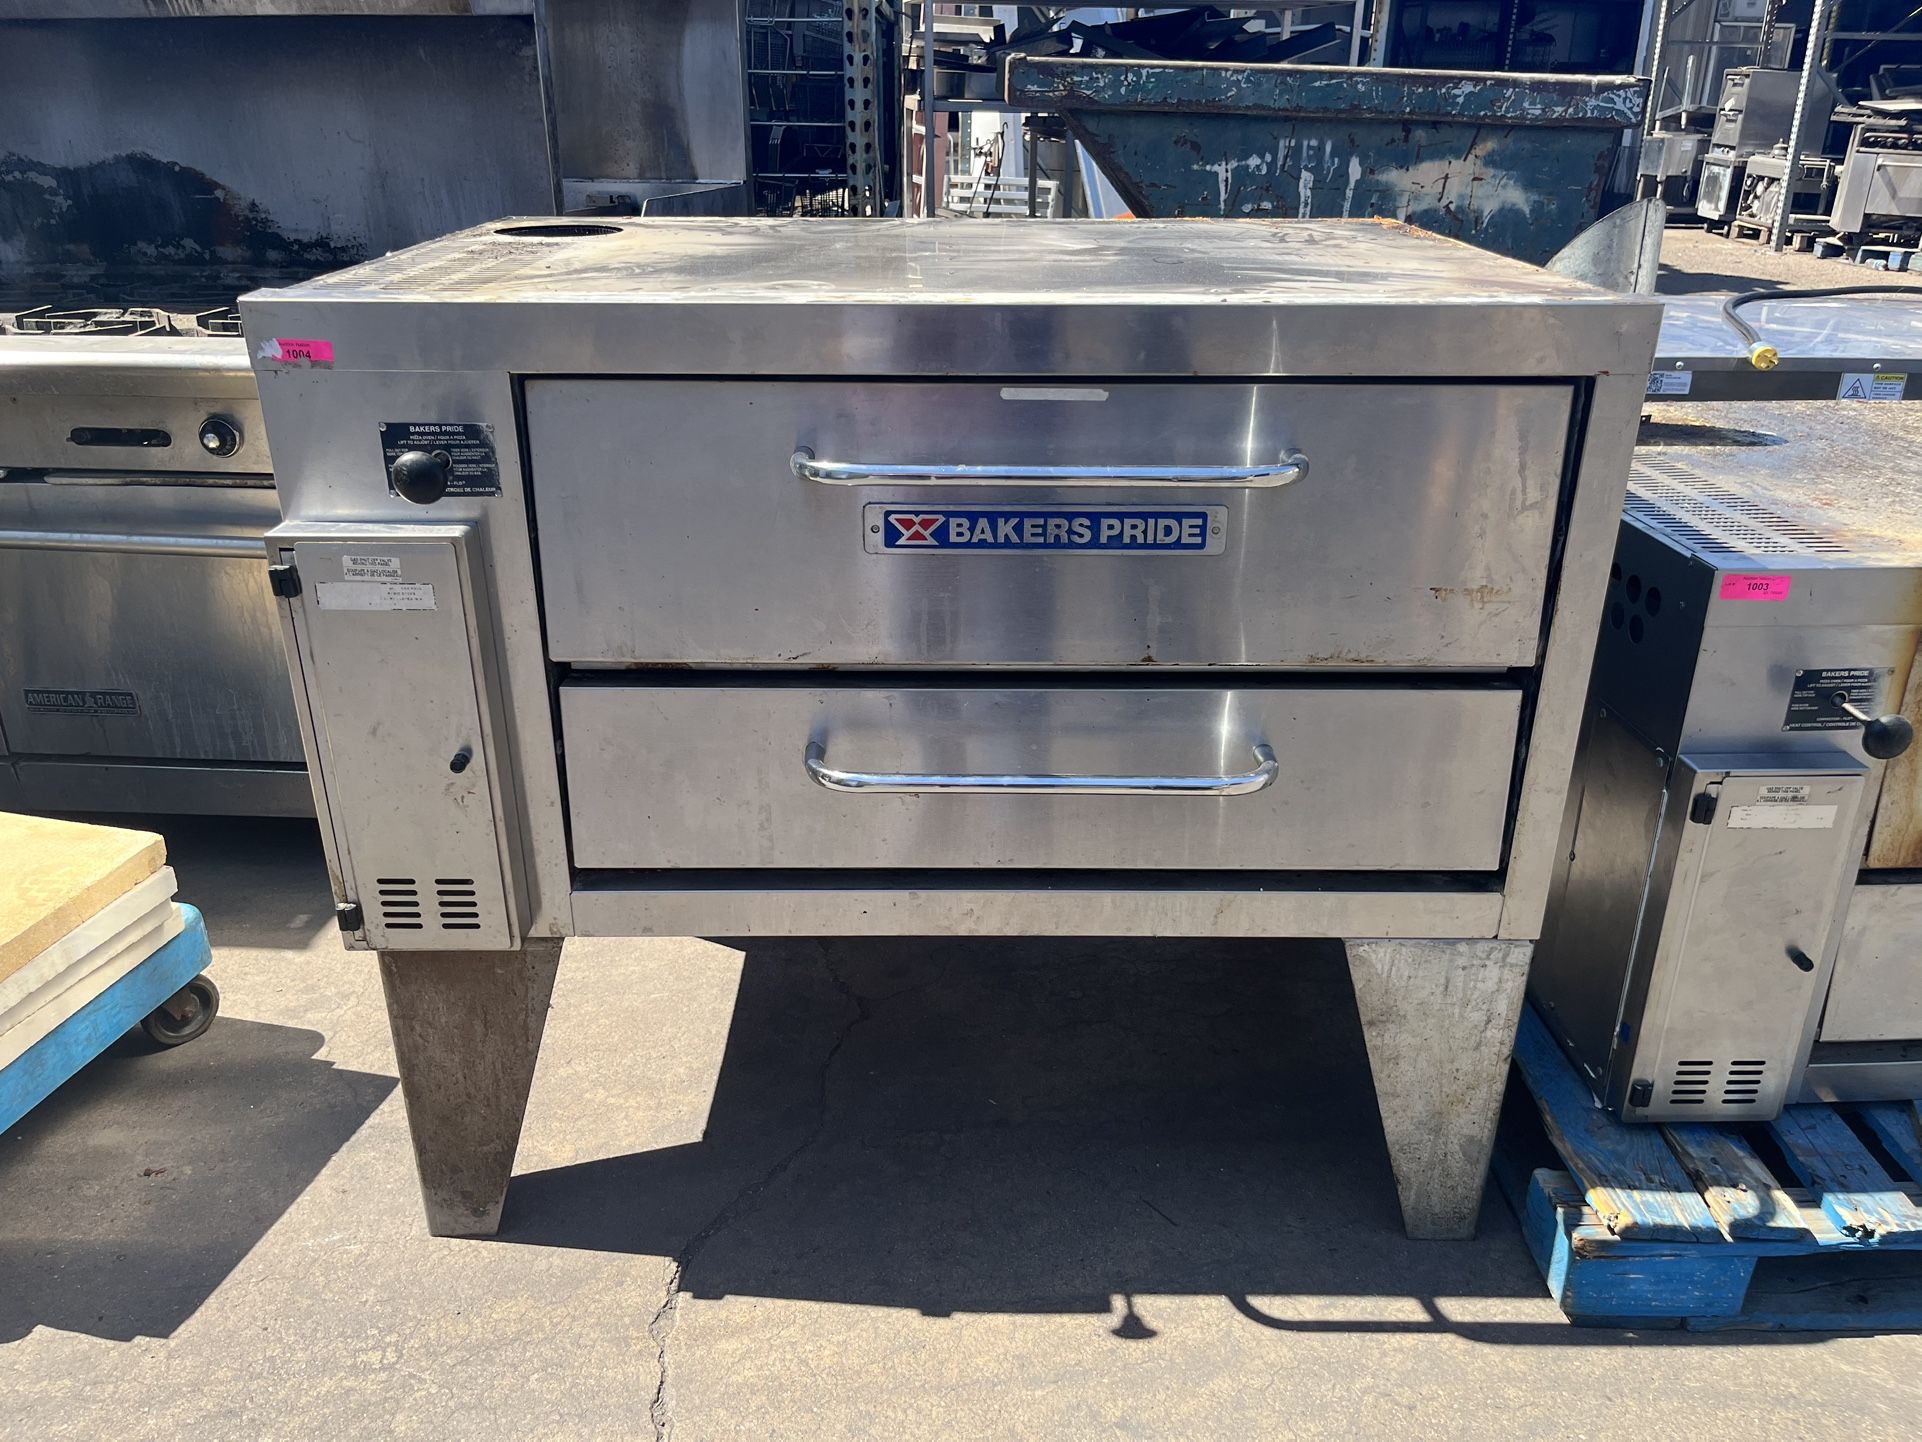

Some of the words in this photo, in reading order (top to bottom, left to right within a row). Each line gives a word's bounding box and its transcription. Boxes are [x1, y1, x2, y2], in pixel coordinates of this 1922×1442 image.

[286, 349, 312, 359] 1004
[949, 516, 1093, 544] BAKERS
[1100, 518, 1204, 544] PRIDE
[1747, 582, 1770, 591] 1003
[27, 693, 83, 706] AMERICAN
[96, 694, 134, 708] RANGE
